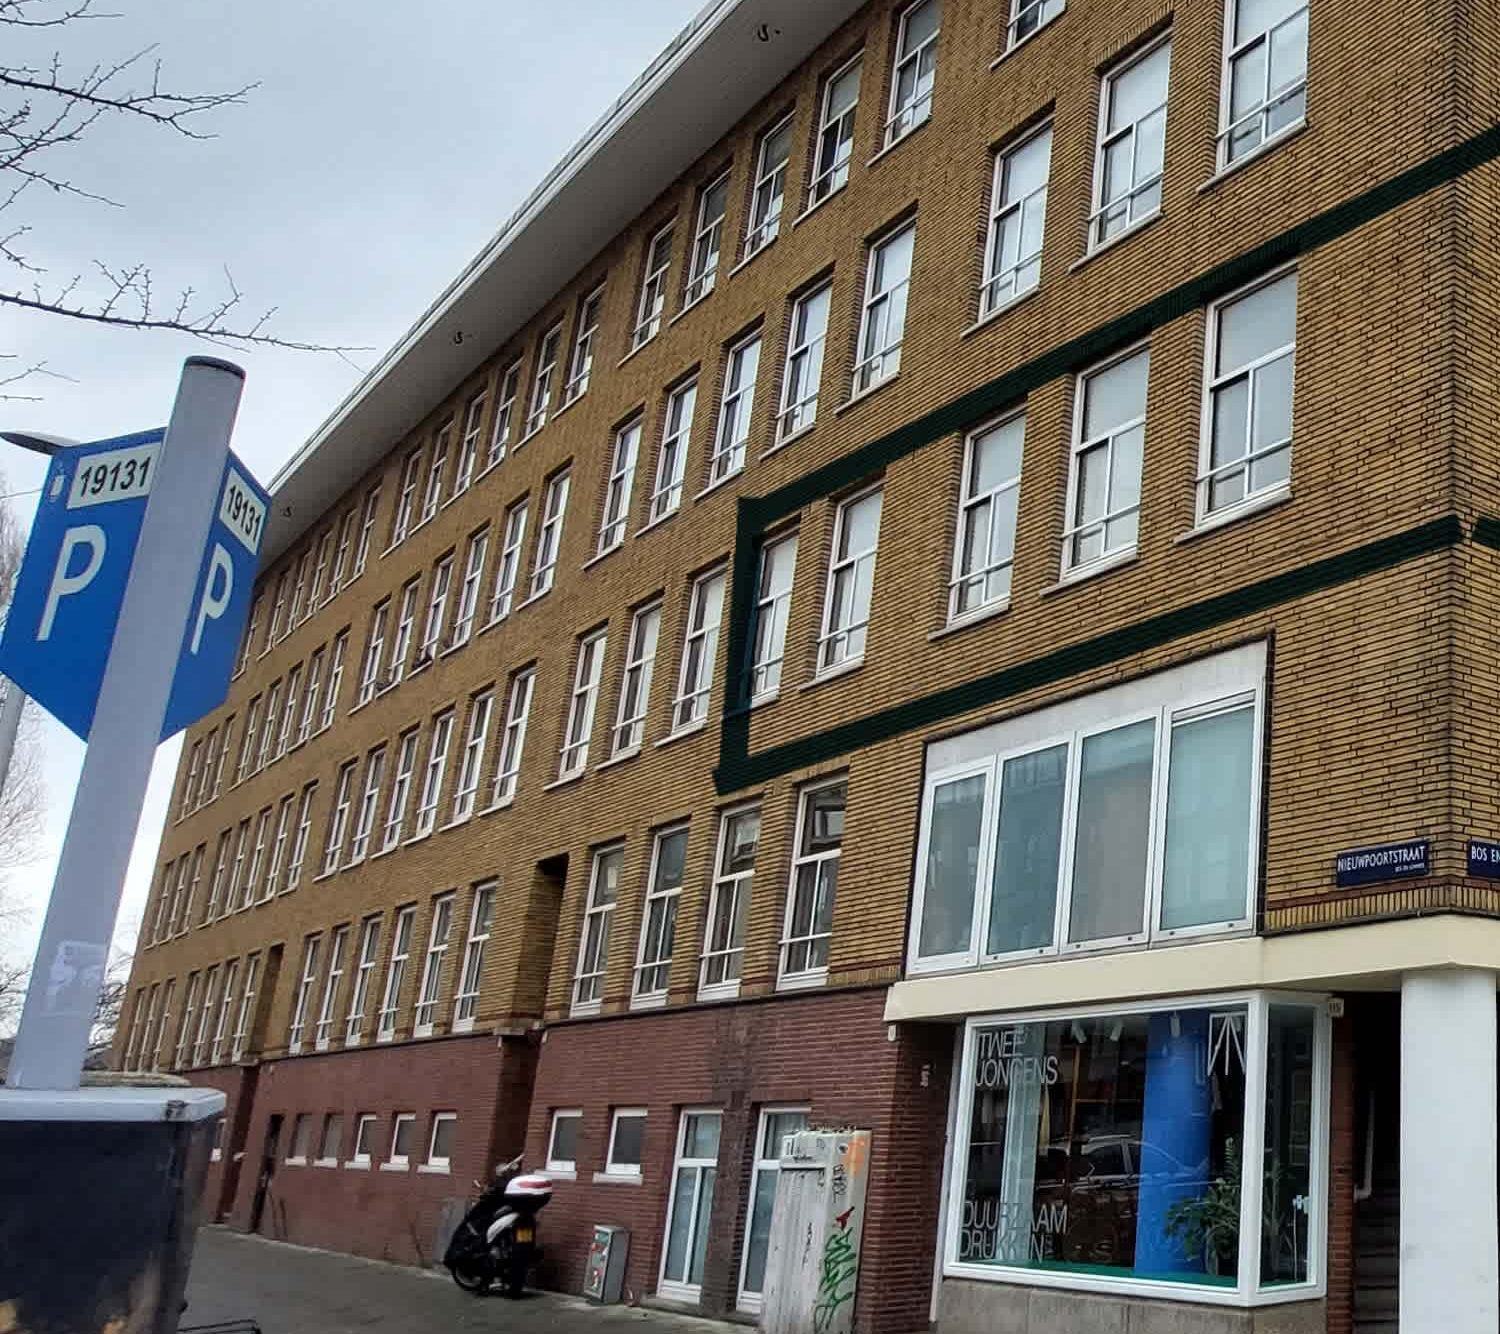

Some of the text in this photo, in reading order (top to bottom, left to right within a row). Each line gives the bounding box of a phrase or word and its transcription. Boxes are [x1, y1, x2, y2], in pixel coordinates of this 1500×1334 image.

[79, 456, 152, 498] 19131
[226, 484, 262, 543] 19131
[36, 524, 107, 642] P
[190, 543, 234, 655] P
[1337, 846, 1426, 873] NIEUWPOORTSTRAAT
[1471, 845, 1488, 862] BOS
[977, 1030, 1025, 1059] TWEE
[976, 1055, 1059, 1087] JONGENS
